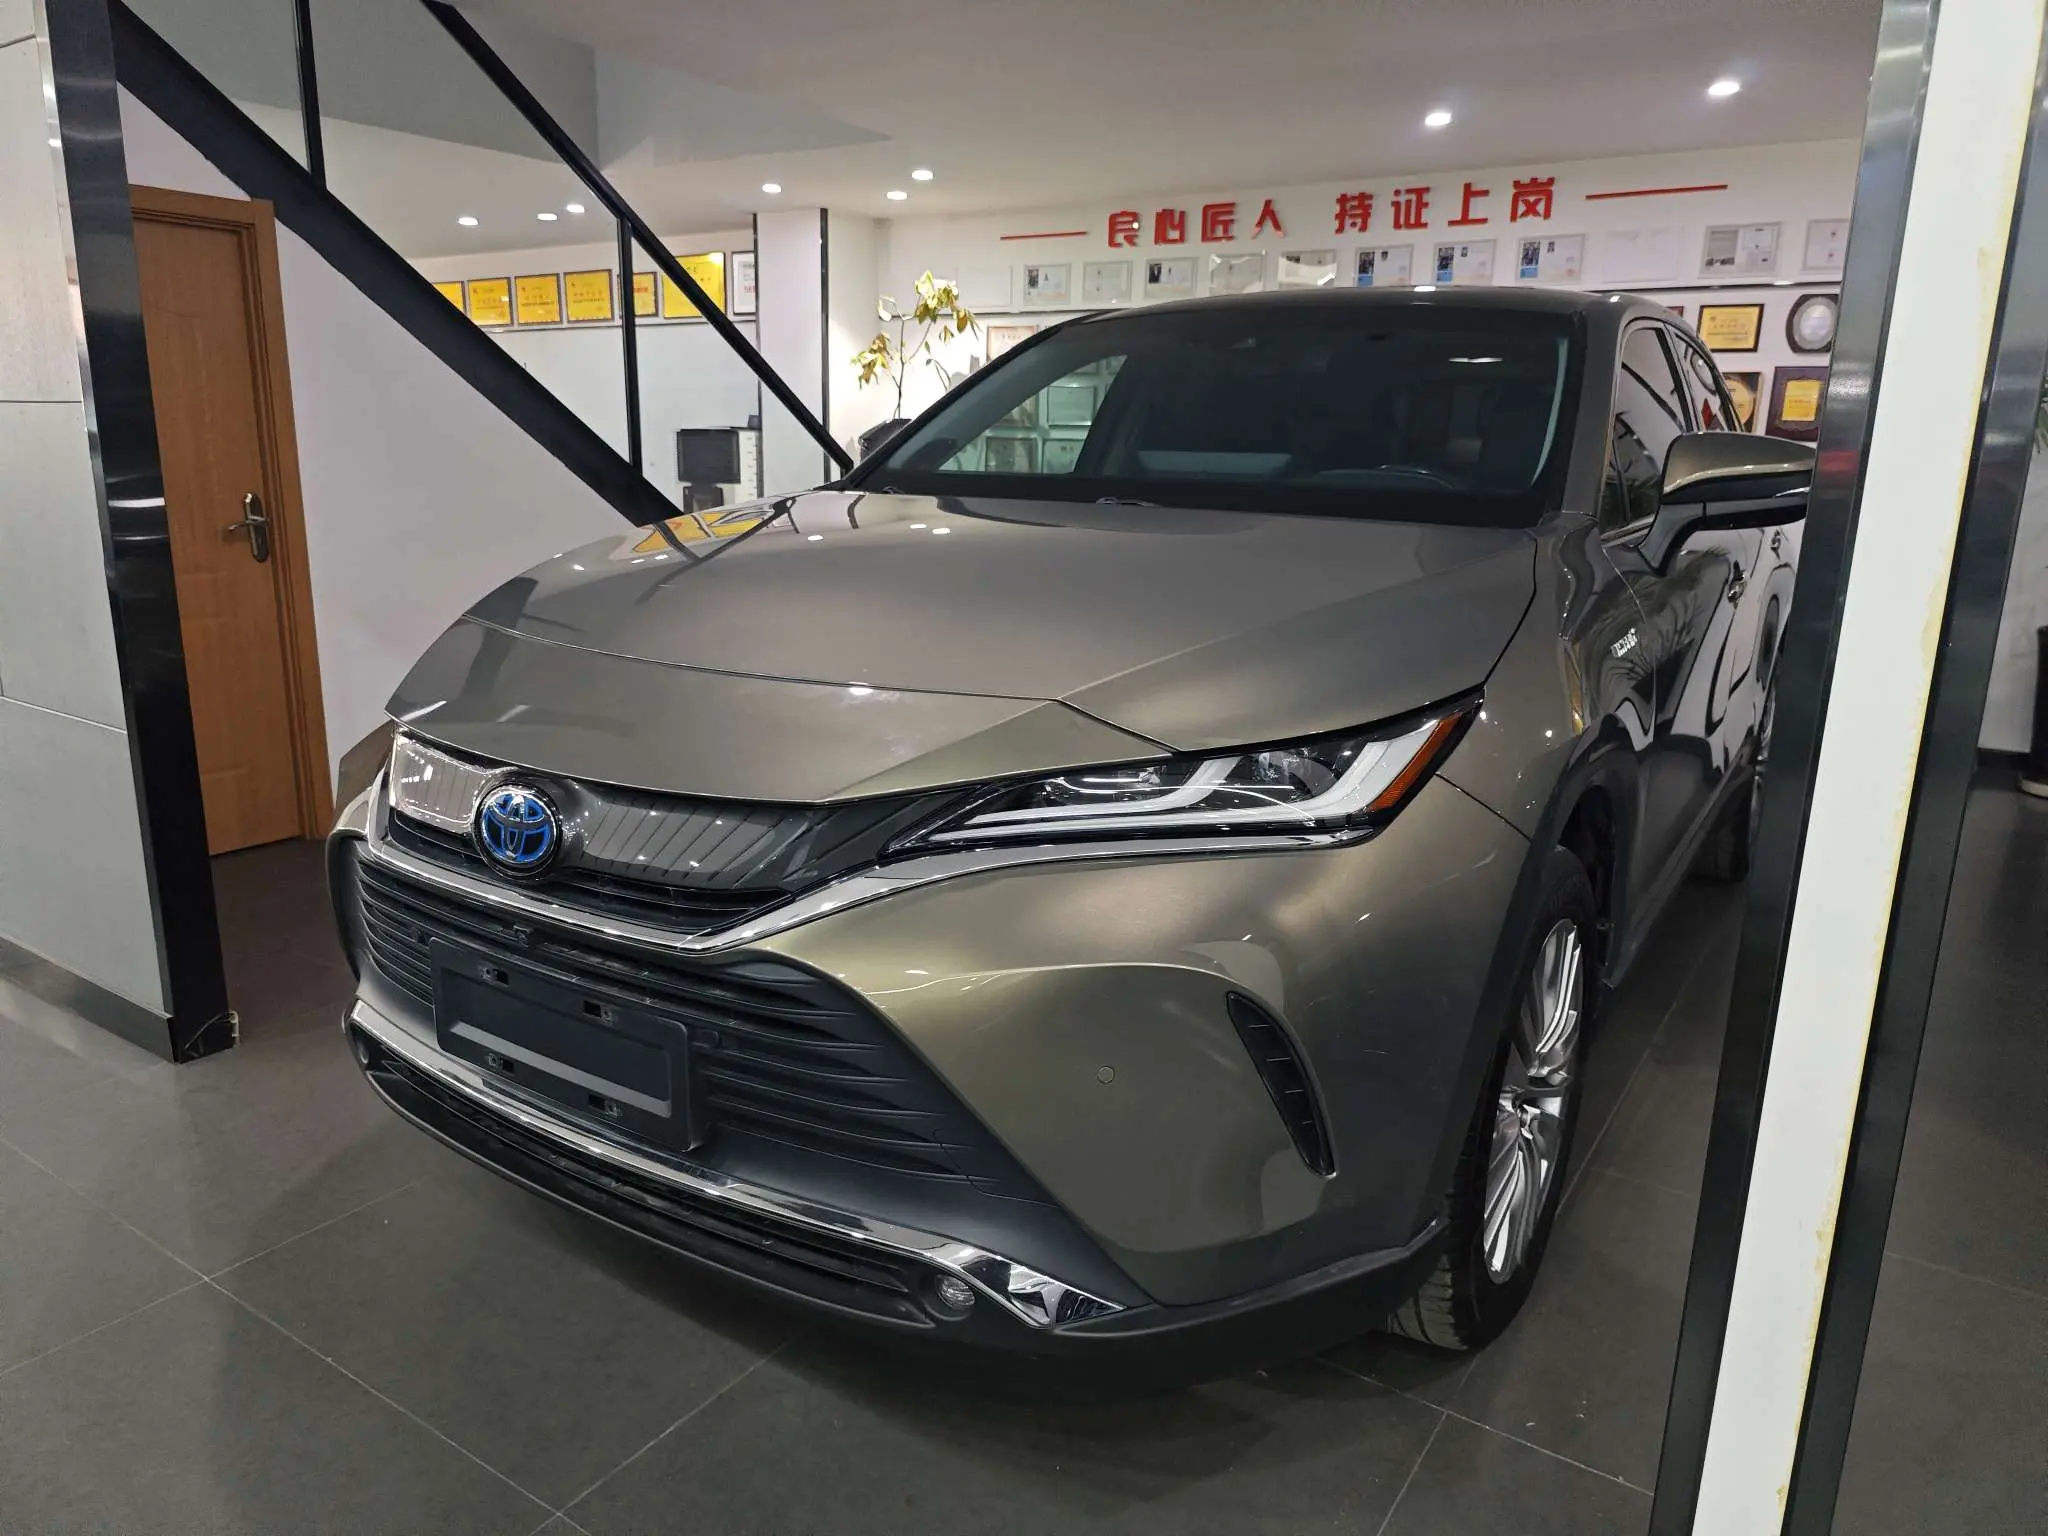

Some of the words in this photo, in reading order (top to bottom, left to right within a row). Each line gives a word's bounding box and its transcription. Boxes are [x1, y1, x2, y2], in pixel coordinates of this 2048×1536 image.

[1108, 199, 1286, 248] 良心匠人
[1334, 177, 1556, 234] 持证上岗
